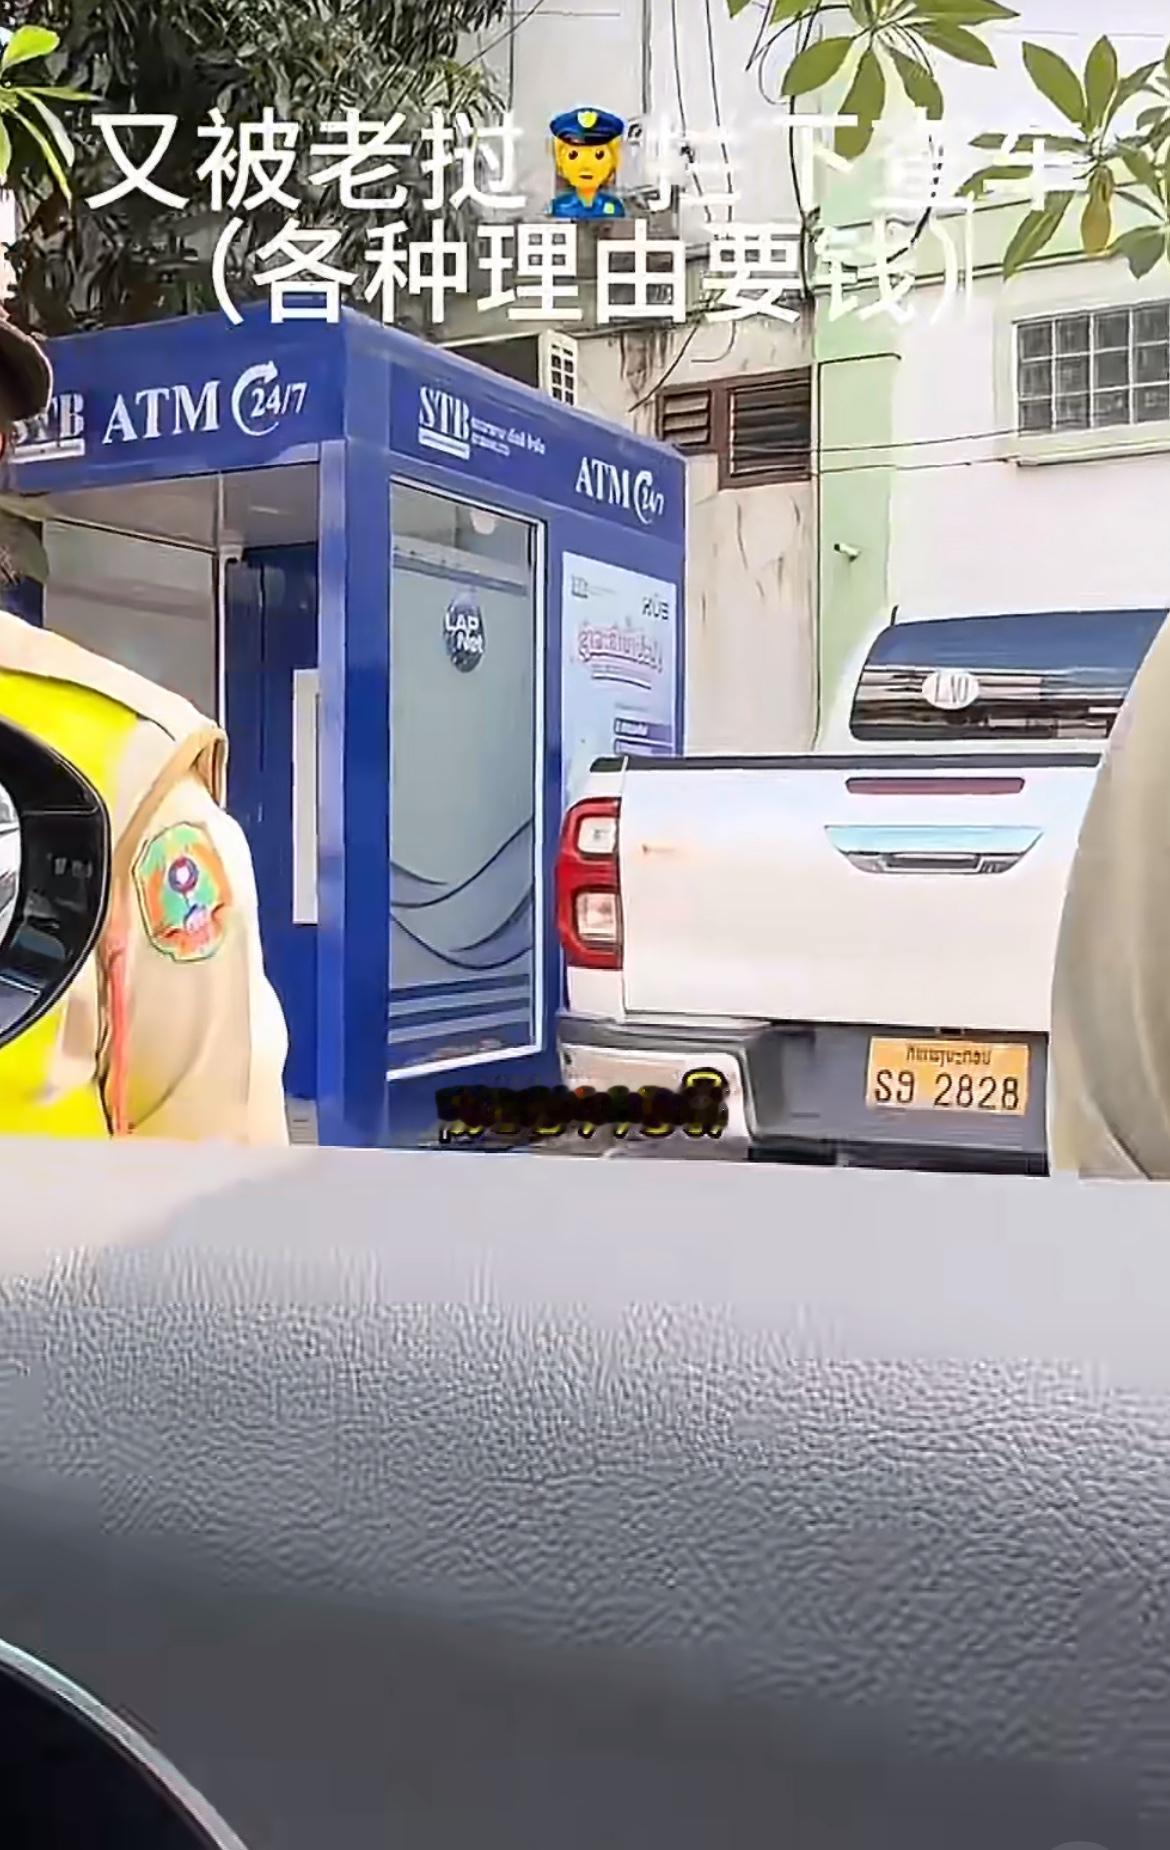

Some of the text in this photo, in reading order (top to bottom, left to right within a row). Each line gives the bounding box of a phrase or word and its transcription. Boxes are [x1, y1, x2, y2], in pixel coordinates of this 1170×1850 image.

[101, 380, 221, 445] ATM
[250, 381, 308, 418] 24/7
[418, 385, 471, 441] STB
[575, 456, 630, 509] ATM
[933, 1071, 1020, 1111] 2828
